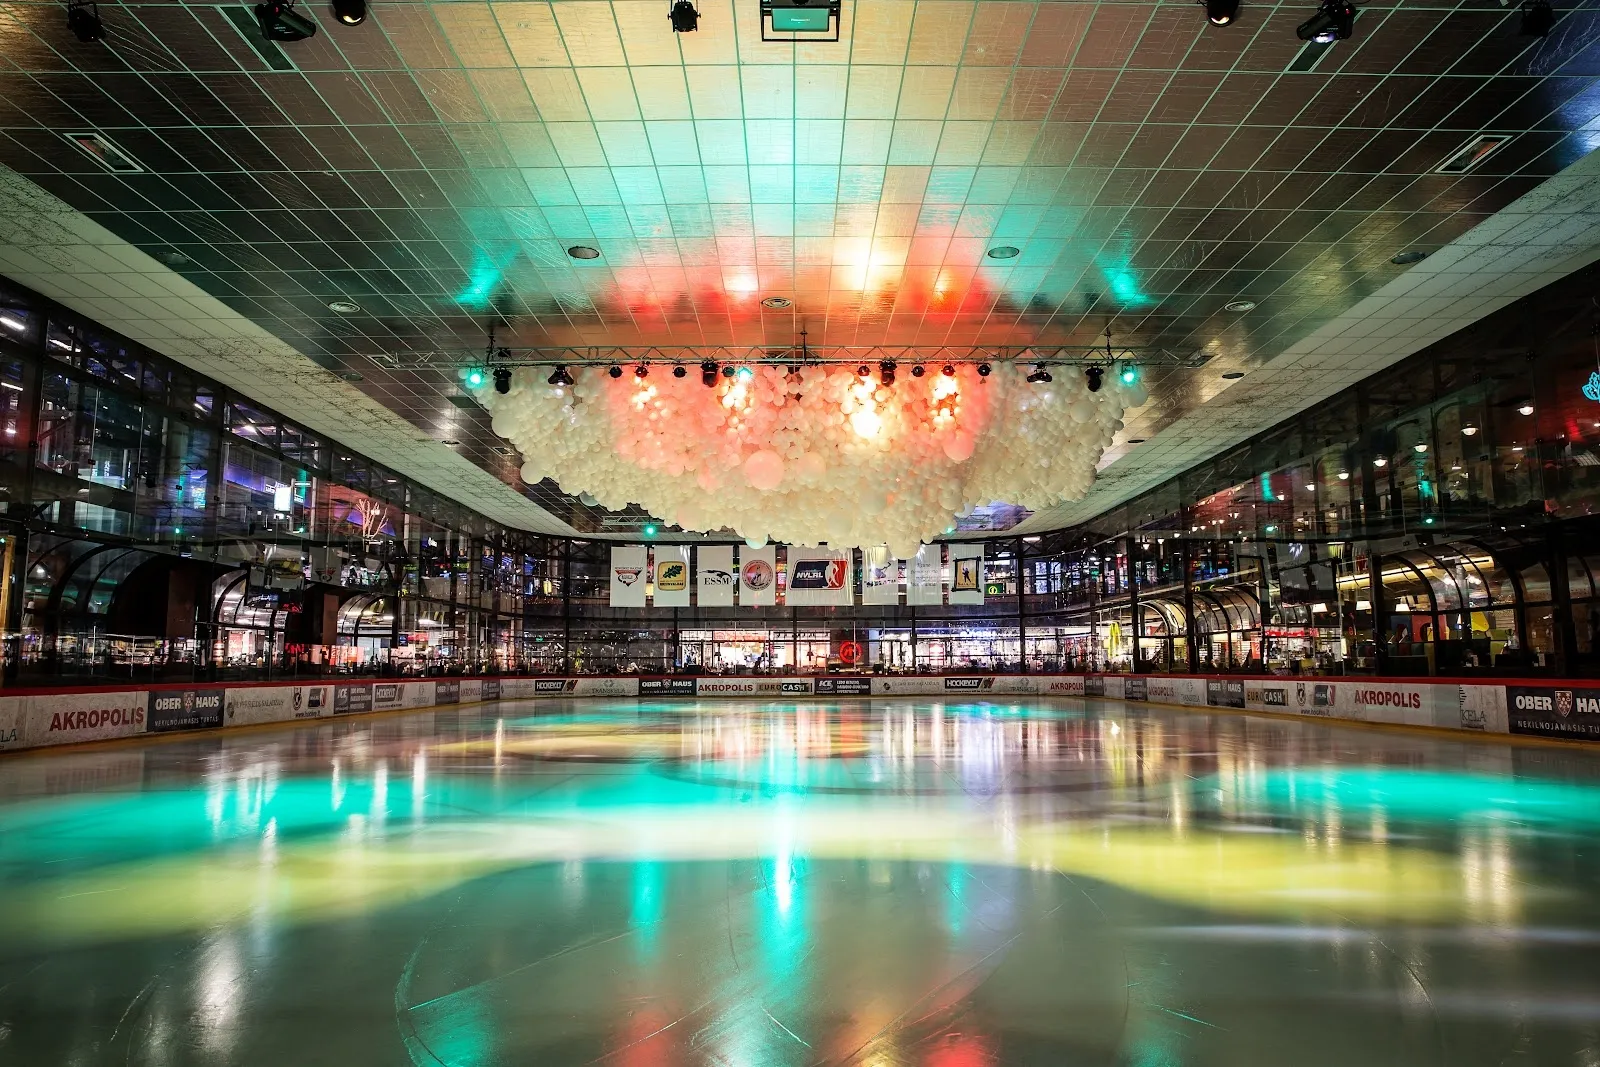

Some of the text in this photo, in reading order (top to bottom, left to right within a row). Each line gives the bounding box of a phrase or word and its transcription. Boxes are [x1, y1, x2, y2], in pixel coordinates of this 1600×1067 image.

[704, 577, 730, 585] ESSM
[697, 684, 753, 692] AKROPOLIS
[1050, 682, 1084, 691] AKROPOLIS
[1148, 686, 1175, 697] AKROPOLIS
[1208, 682, 1241, 692] OBER HAUS
[155, 697, 182, 711] OBER
[195, 696, 220, 708] HAUS
[1354, 690, 1421, 709] AKROPOLIS
[1515, 695, 1600, 714] OBER HA
[49, 707, 145, 732] AKROPOLIS
[1517, 720, 1586, 733] NEKILNOJAMASIS
